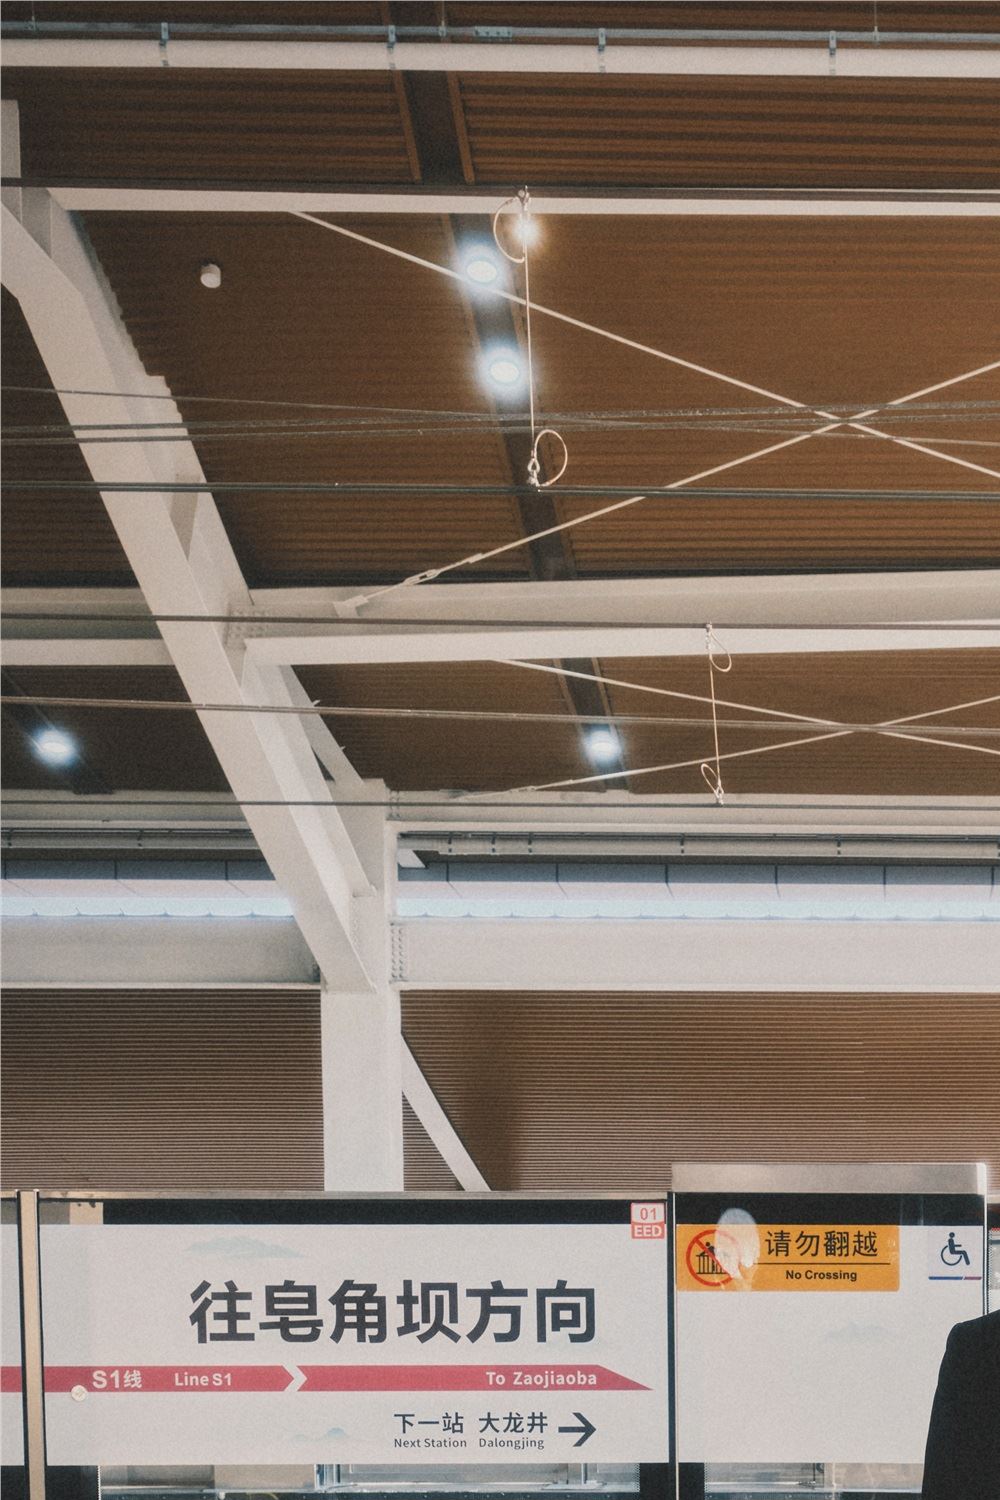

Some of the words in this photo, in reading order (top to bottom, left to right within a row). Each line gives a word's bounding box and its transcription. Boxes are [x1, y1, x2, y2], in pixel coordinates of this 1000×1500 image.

[640, 1208, 656, 1220] 01
[634, 1225, 662, 1237] EED
[765, 1230, 878, 1257] 请勿翻越
[785, 1270, 802, 1280] No
[805, 1270, 857, 1281] Crossing
[189, 1279, 596, 1344] 往皂角坝方向
[92, 1369, 143, 1389] S1线
[174, 1372, 209, 1386] Line
[212, 1373, 232, 1386] S1
[486, 1371, 506, 1385] To
[513, 1370, 597, 1388] Zaojiaoba
[394, 1412, 465, 1434] 下一站
[479, 1412, 548, 1434] 大龙井
[394, 1438, 421, 1448] Next
[424, 1438, 467, 1448] Station
[479, 1437, 545, 1450] Dalongjing
